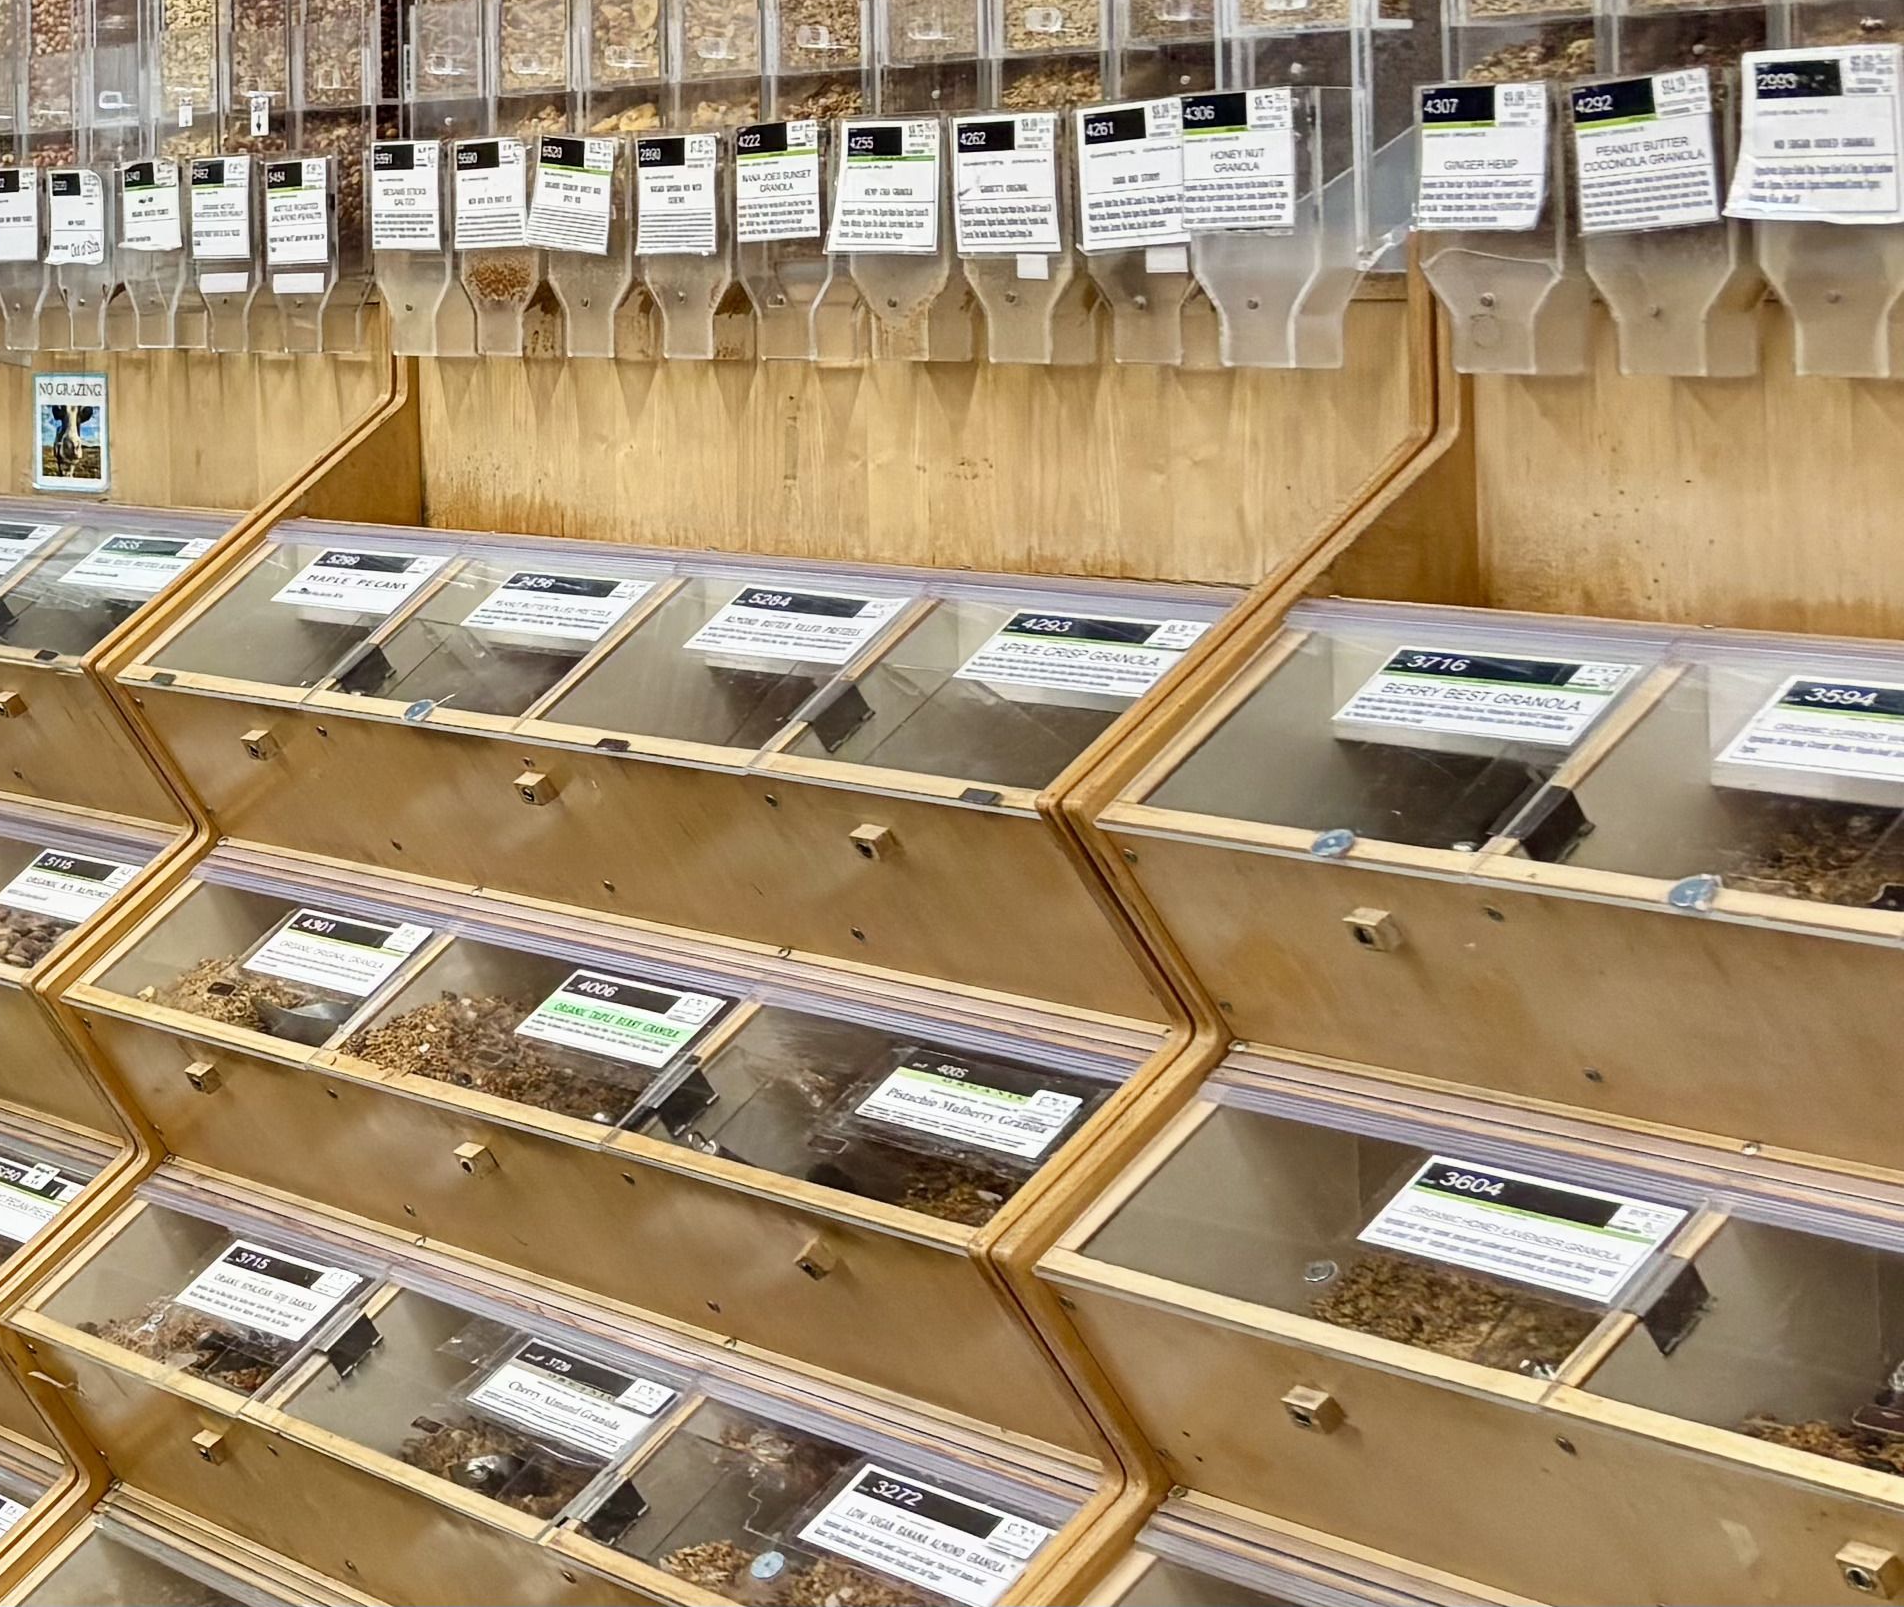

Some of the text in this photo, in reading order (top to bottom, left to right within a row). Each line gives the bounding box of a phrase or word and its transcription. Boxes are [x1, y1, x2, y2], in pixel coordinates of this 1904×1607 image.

[1183, 106, 1215, 121] 4306
[1423, 97, 1460, 115] 4307
[1575, 95, 1614, 114] 4292
[1086, 121, 1115, 137] 4261
[959, 131, 987, 146] 4262
[1596, 136, 1690, 157] PEANUT BUTTER
[1210, 150, 1242, 160] HONEY
[1649, 149, 1706, 165] GRANOLA
[1213, 162, 1260, 173] GRANOLA
[1443, 159, 1519, 171] GINGER HEMP
[306, 574, 409, 591] MAPLE PECANS
[748, 593, 792, 607] 5284
[1021, 617, 1073, 632] 4293
[994, 643, 1160, 667] APPLE CRISP GRANOLA
[1407, 655, 1471, 672] 3716
[1381, 682, 1582, 711] BERRY BEST GRANOLA
[1805, 688, 1879, 706] 3594
[578, 980, 619, 998] 4006
[885, 1086, 938, 1107] Pistachio
[938, 1100, 993, 1123] Mulberry
[1440, 1171, 1505, 1197] 3604
[1409, 1205, 1622, 1262] ORGANIC HONEY LAVENDER GRANOLA
[235, 1252, 273, 1270] 3715
[507, 1380, 622, 1431] Cherry Almond Granola
[872, 1480, 924, 1507] 3272
[845, 1506, 1007, 1574] LOW SUGAR BANANA ALMOND GRANOLA
